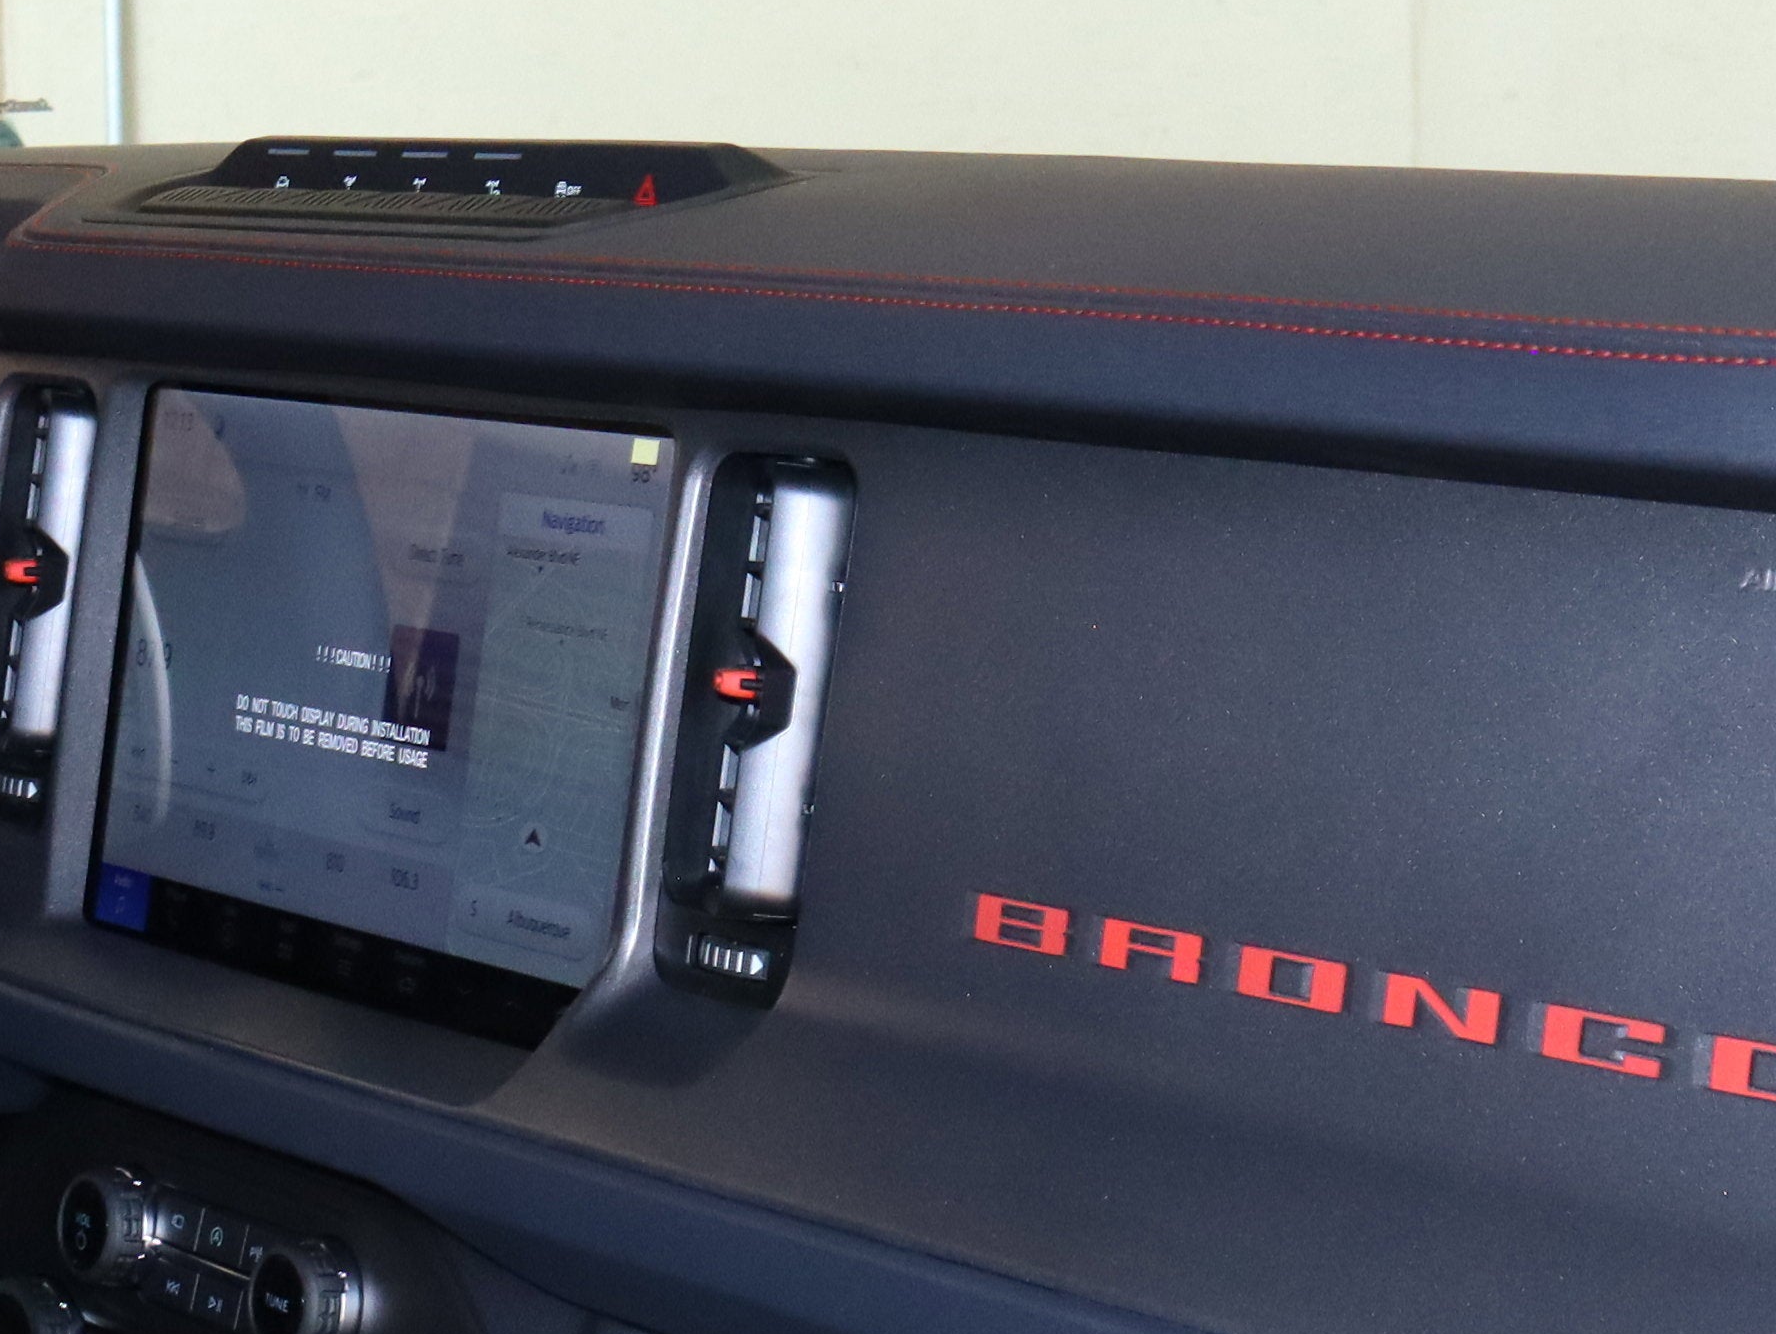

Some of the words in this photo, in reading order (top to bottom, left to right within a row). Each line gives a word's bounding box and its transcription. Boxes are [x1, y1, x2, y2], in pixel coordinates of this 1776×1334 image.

[541, 511, 606, 535] Navigation
[236, 693, 250, 711] DO
[252, 697, 270, 714] NOT
[271, 700, 299, 720] TOUCH
[301, 706, 336, 727] DISPLAY
[336, 713, 369, 734] DURING
[370, 719, 431, 746] INSTALLATION
[235, 714, 253, 733] THIS
[255, 719, 275, 737] FILM
[275, 723, 286, 740] IS
[288, 725, 301, 742] TO
[302, 728, 316, 746] BE
[317, 731, 359, 754] REMOVED
[360, 739, 396, 762] BEFORE
[398, 748, 429, 768] USAGE
[265, 1292, 290, 1314] TUNE
